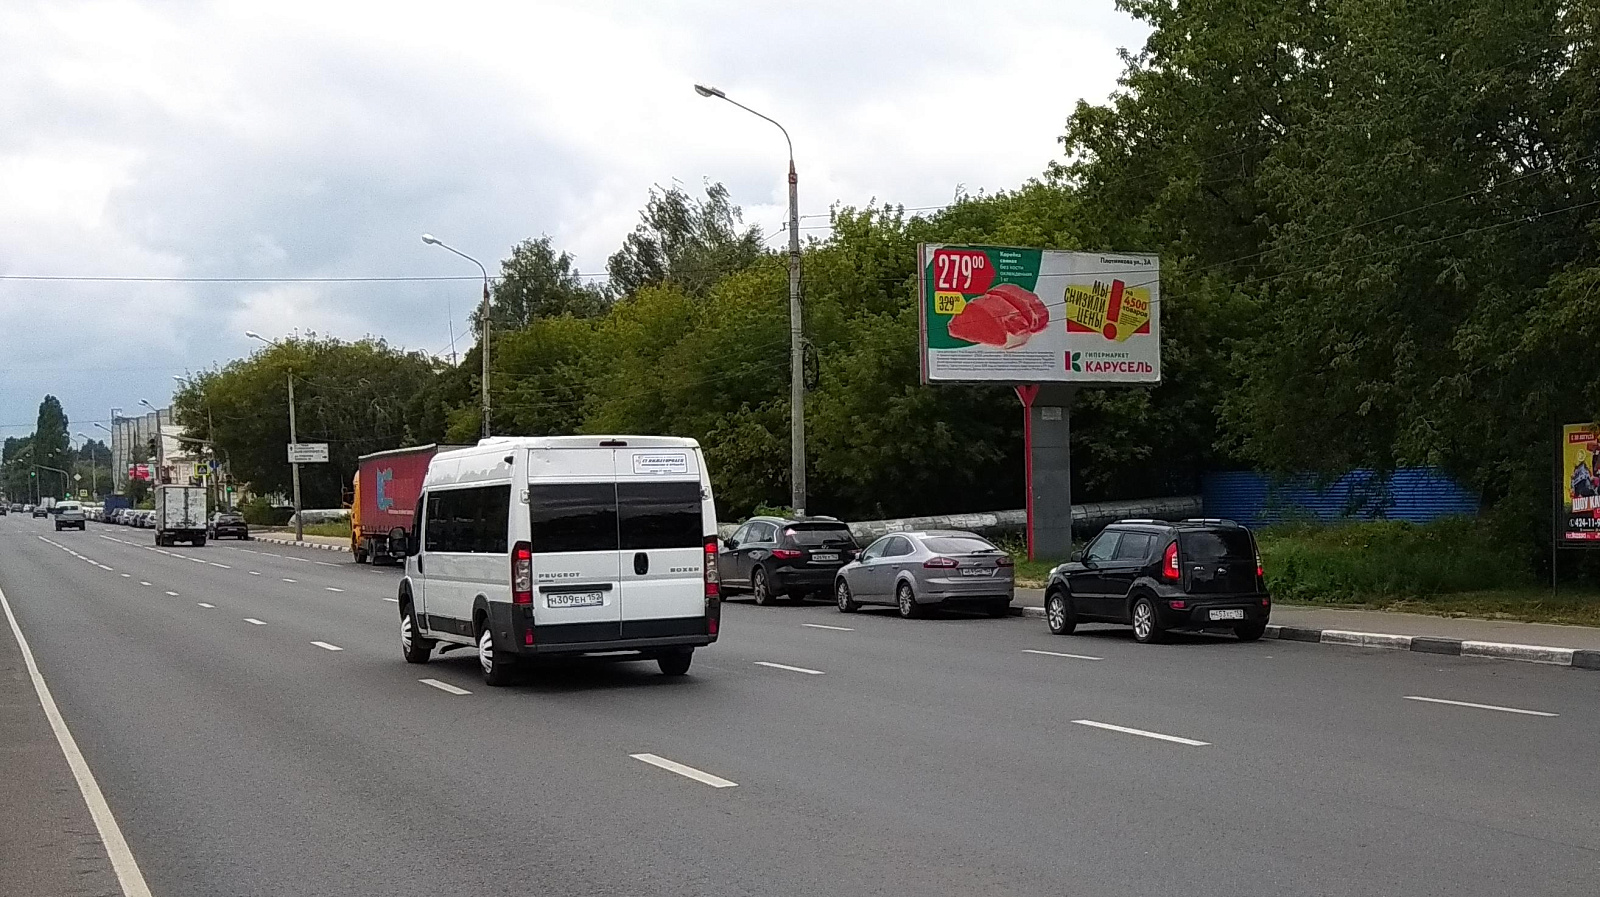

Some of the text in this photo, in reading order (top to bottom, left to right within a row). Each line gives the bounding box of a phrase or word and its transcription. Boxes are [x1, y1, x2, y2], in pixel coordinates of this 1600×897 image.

[1092, 280, 1109, 298] МЫ
[1064, 287, 1106, 314] СНИЗИЛИ
[1123, 296, 1148, 311] 4500
[1077, 307, 1104, 329] ЦЕНЫ
[1085, 360, 1153, 373] КАРУСЕЛЬ
